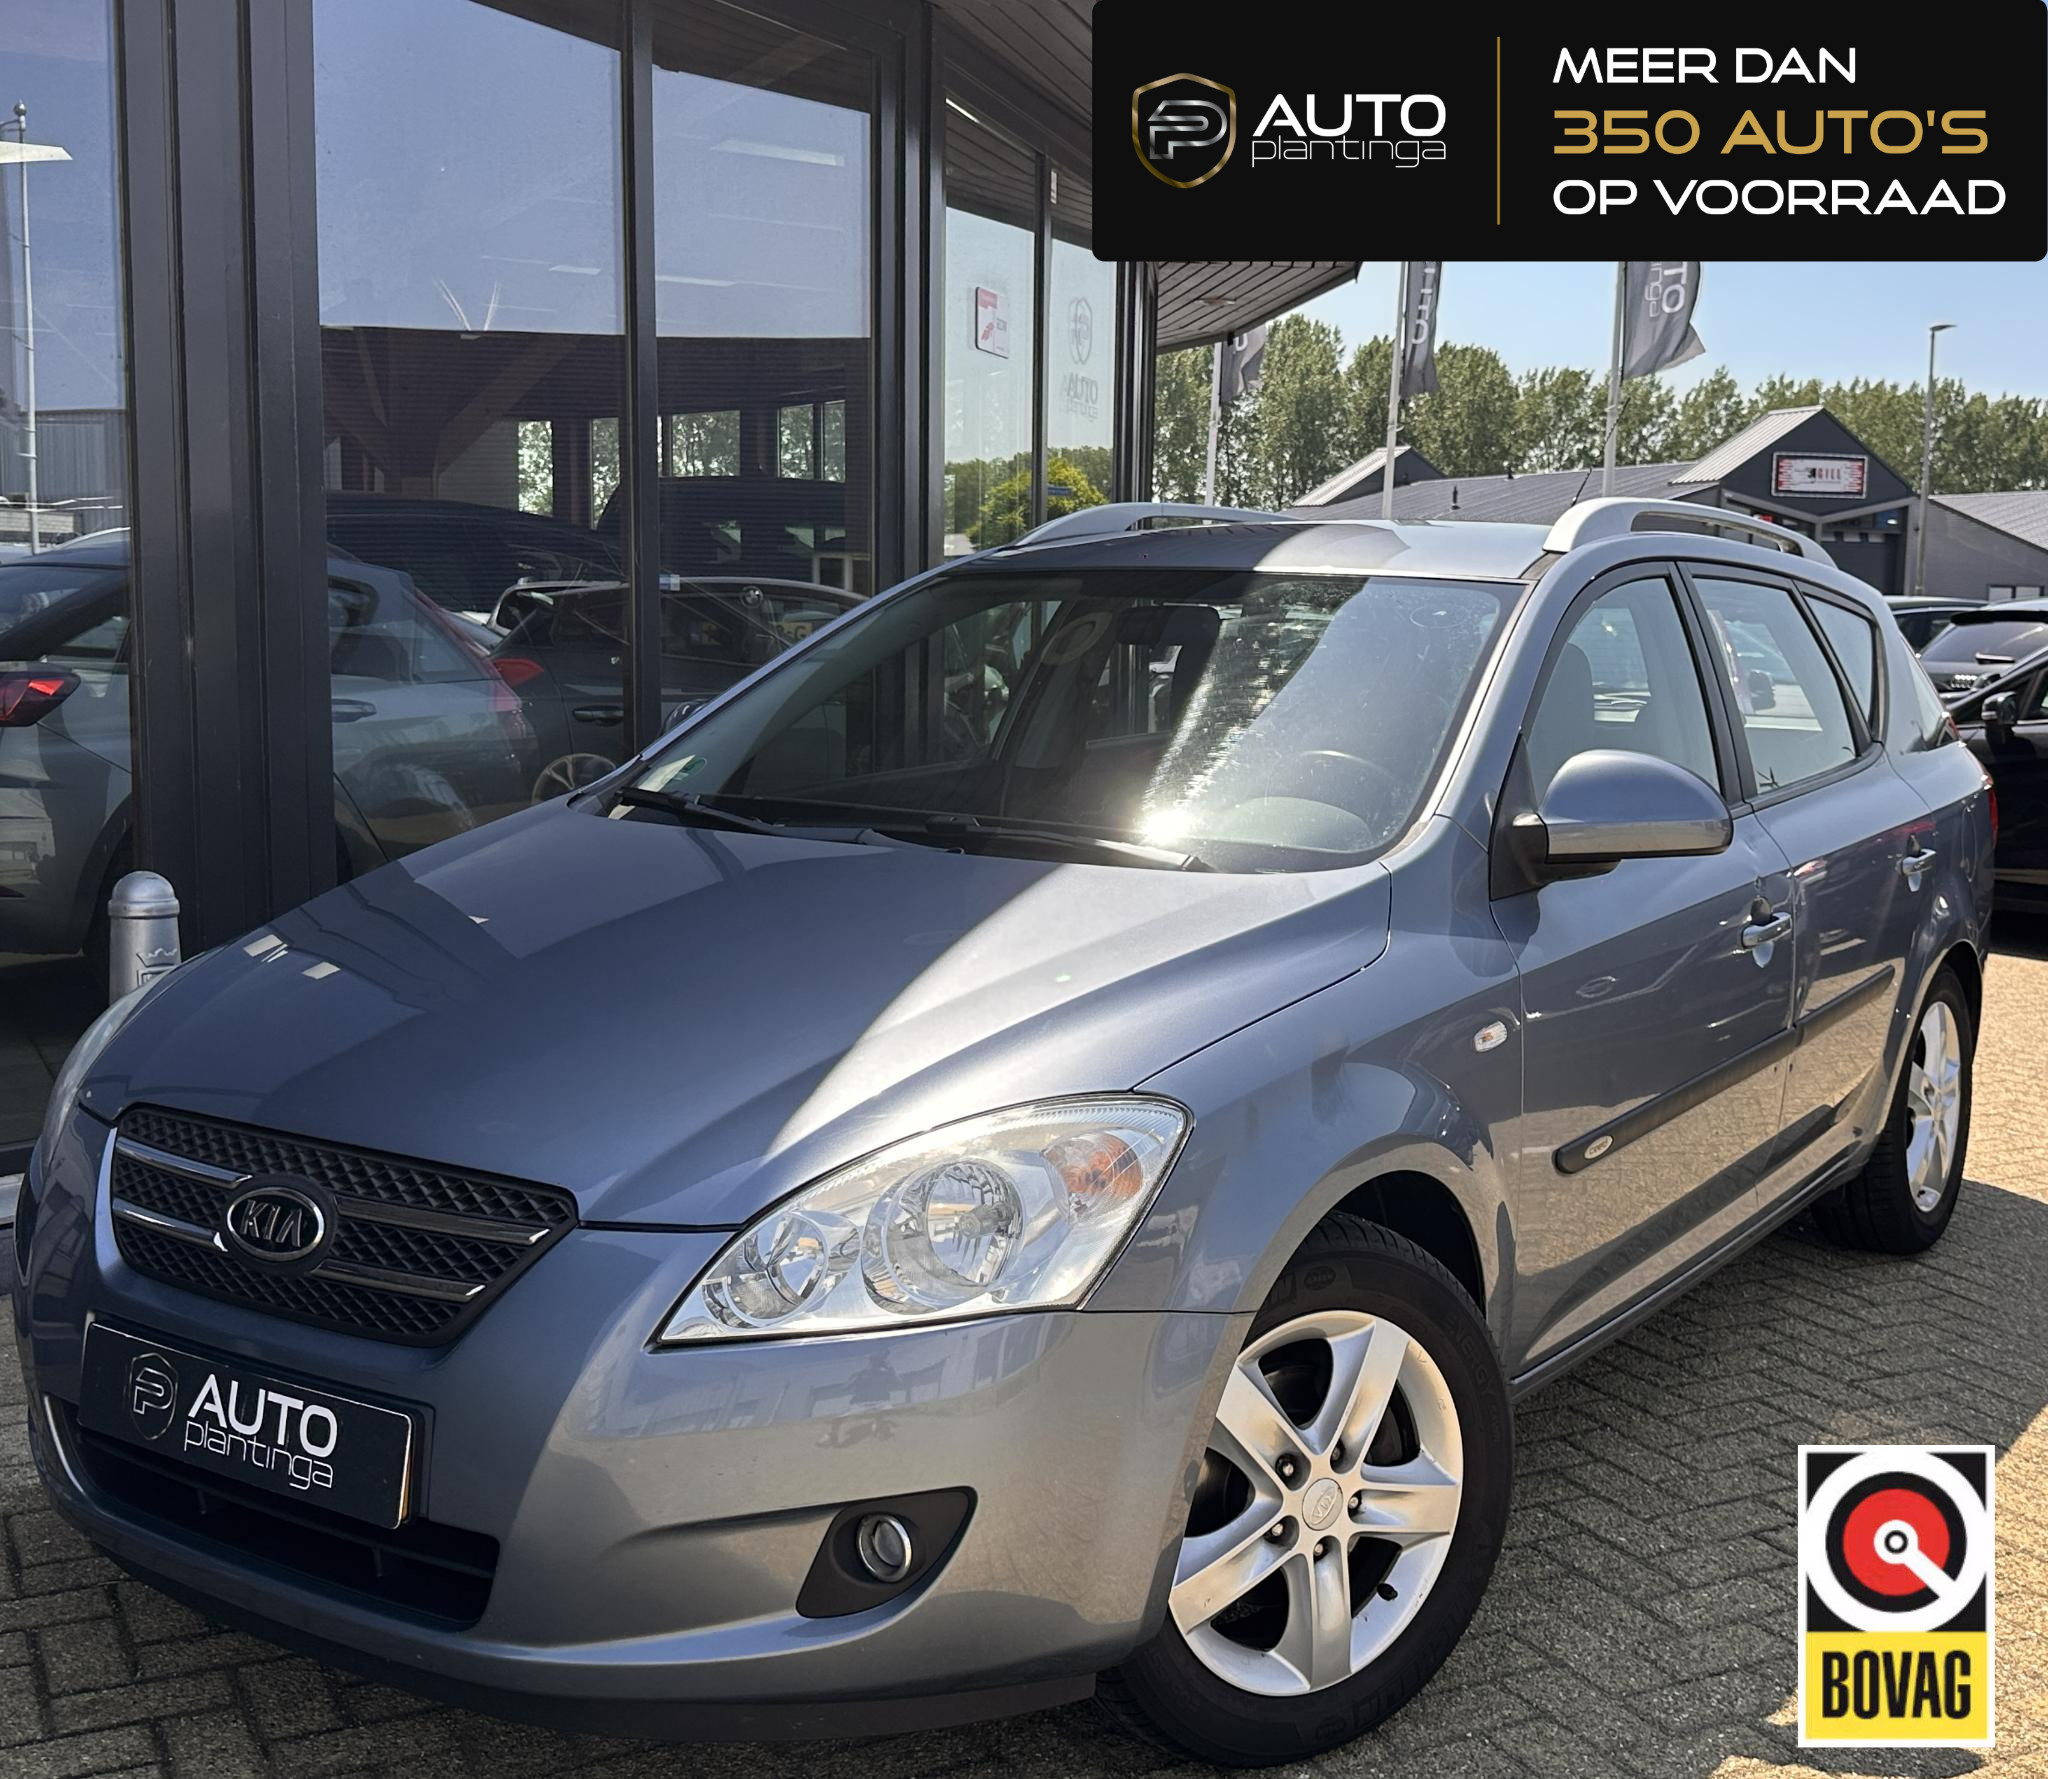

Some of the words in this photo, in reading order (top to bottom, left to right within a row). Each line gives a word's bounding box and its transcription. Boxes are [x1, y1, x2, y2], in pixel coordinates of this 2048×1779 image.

[1661, 261, 1688, 314] TO
[240, 1199, 302, 1248] KIA
[187, 1373, 339, 1459] AUTO
[183, 1419, 334, 1490] plantinga
